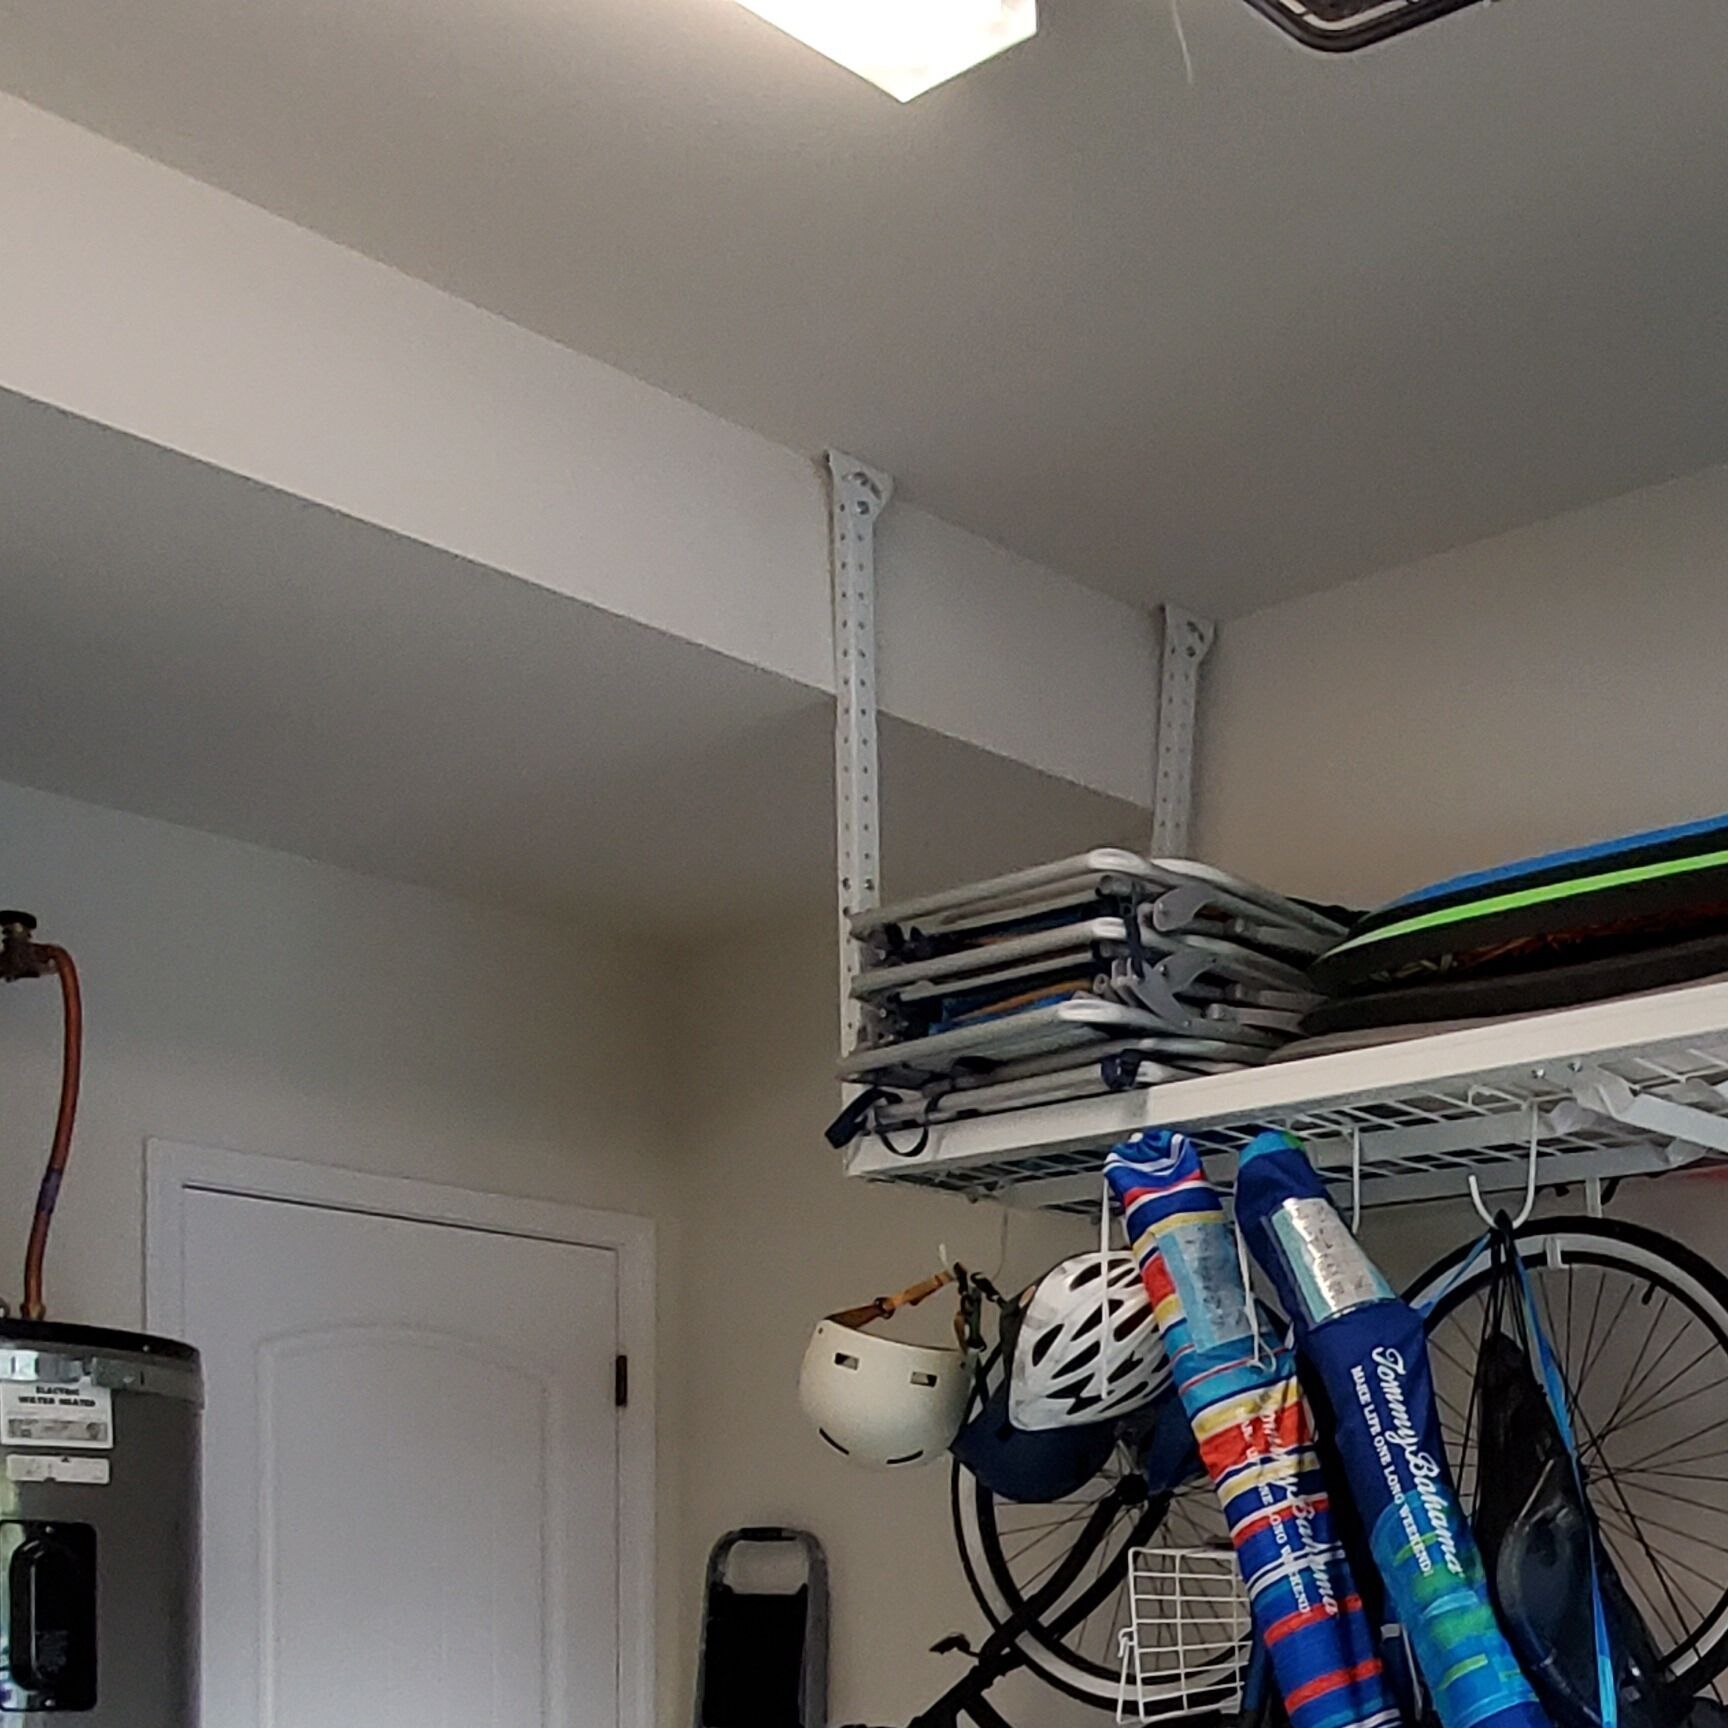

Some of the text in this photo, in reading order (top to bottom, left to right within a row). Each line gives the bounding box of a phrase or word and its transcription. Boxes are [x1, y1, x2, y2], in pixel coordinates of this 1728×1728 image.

[1350, 1365, 1372, 1405] MAKE
[1363, 1404, 1382, 1436] LIFE
[1373, 1436, 1392, 1466] ONE
[1384, 1465, 1405, 1504] LONG
[1371, 1346, 1463, 1575] Tommy Bahama
